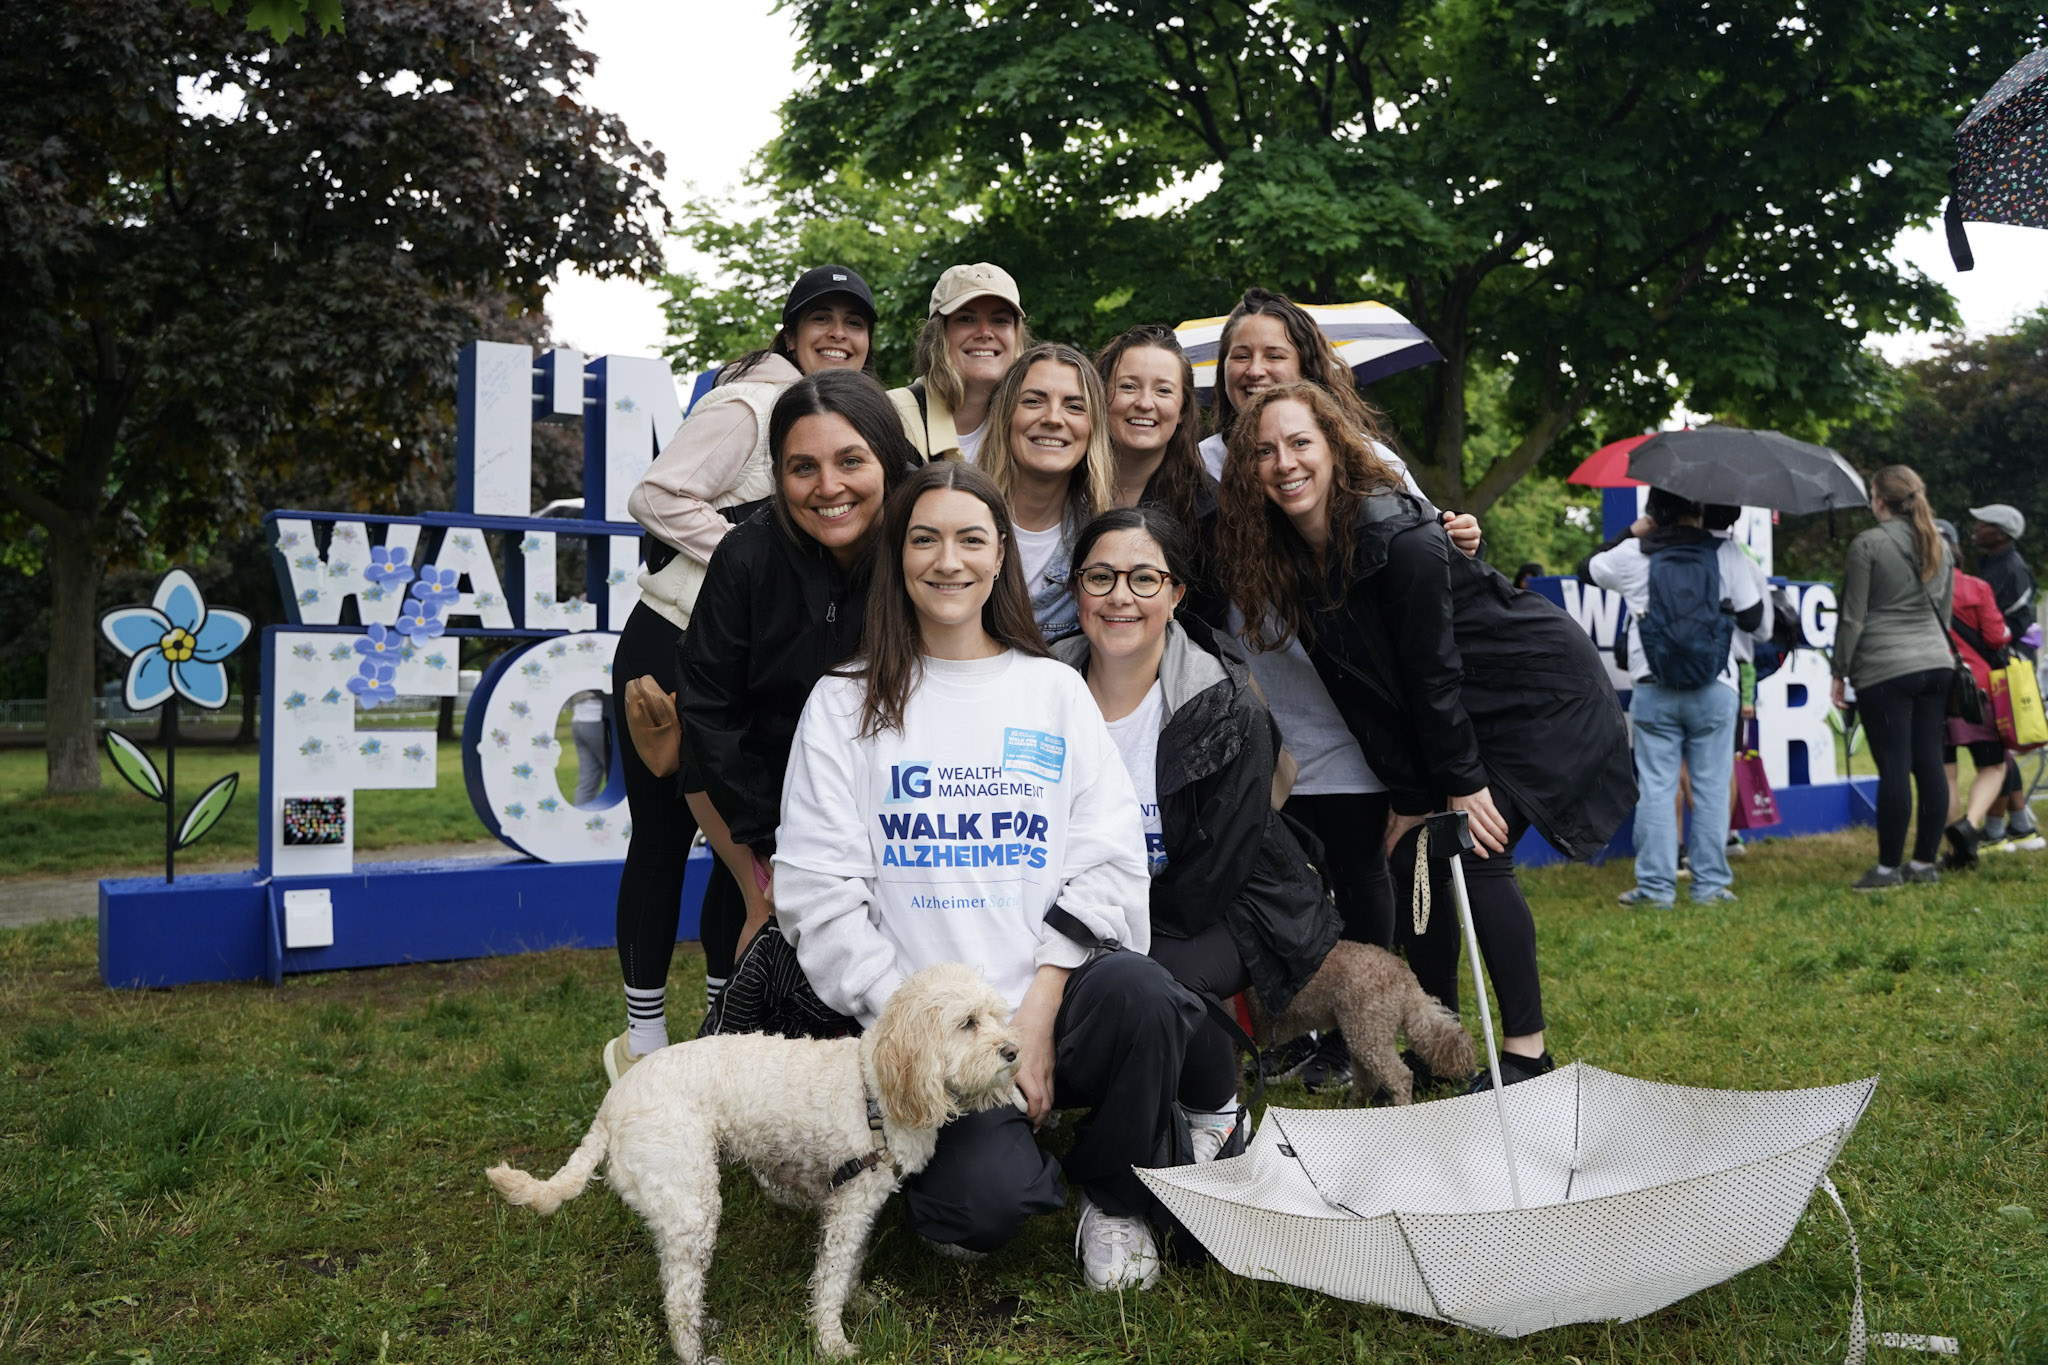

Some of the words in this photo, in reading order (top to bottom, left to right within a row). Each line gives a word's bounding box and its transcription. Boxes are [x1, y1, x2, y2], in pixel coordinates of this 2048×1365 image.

[891, 764, 932, 799] IG
[938, 766, 1002, 781] WEALTH
[938, 783, 1044, 799] MANAGEMENT
[878, 812, 983, 840] WALK
[991, 811, 1049, 843] FOR
